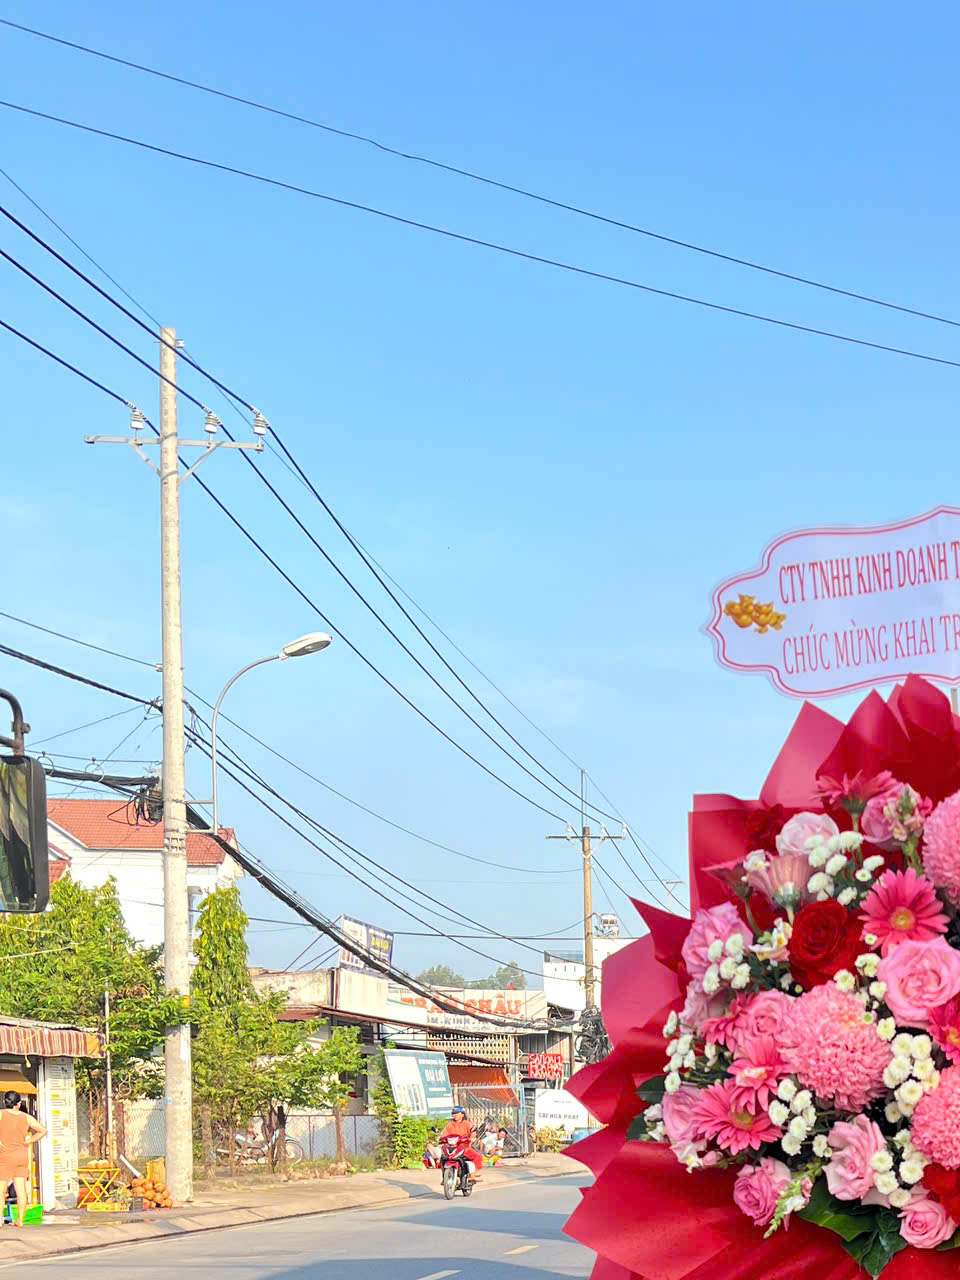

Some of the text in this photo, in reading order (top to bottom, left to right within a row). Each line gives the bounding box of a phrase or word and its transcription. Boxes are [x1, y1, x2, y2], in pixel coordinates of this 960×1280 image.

[779, 562, 806, 605] CTY
[809, 558, 853, 601] TNHH
[855, 552, 894, 595] KINH
[896, 541, 949, 588] DOANH
[783, 624, 831, 675] CHÚC
[834, 619, 889, 669] MỪNG
[893, 616, 937, 659] KHAI
